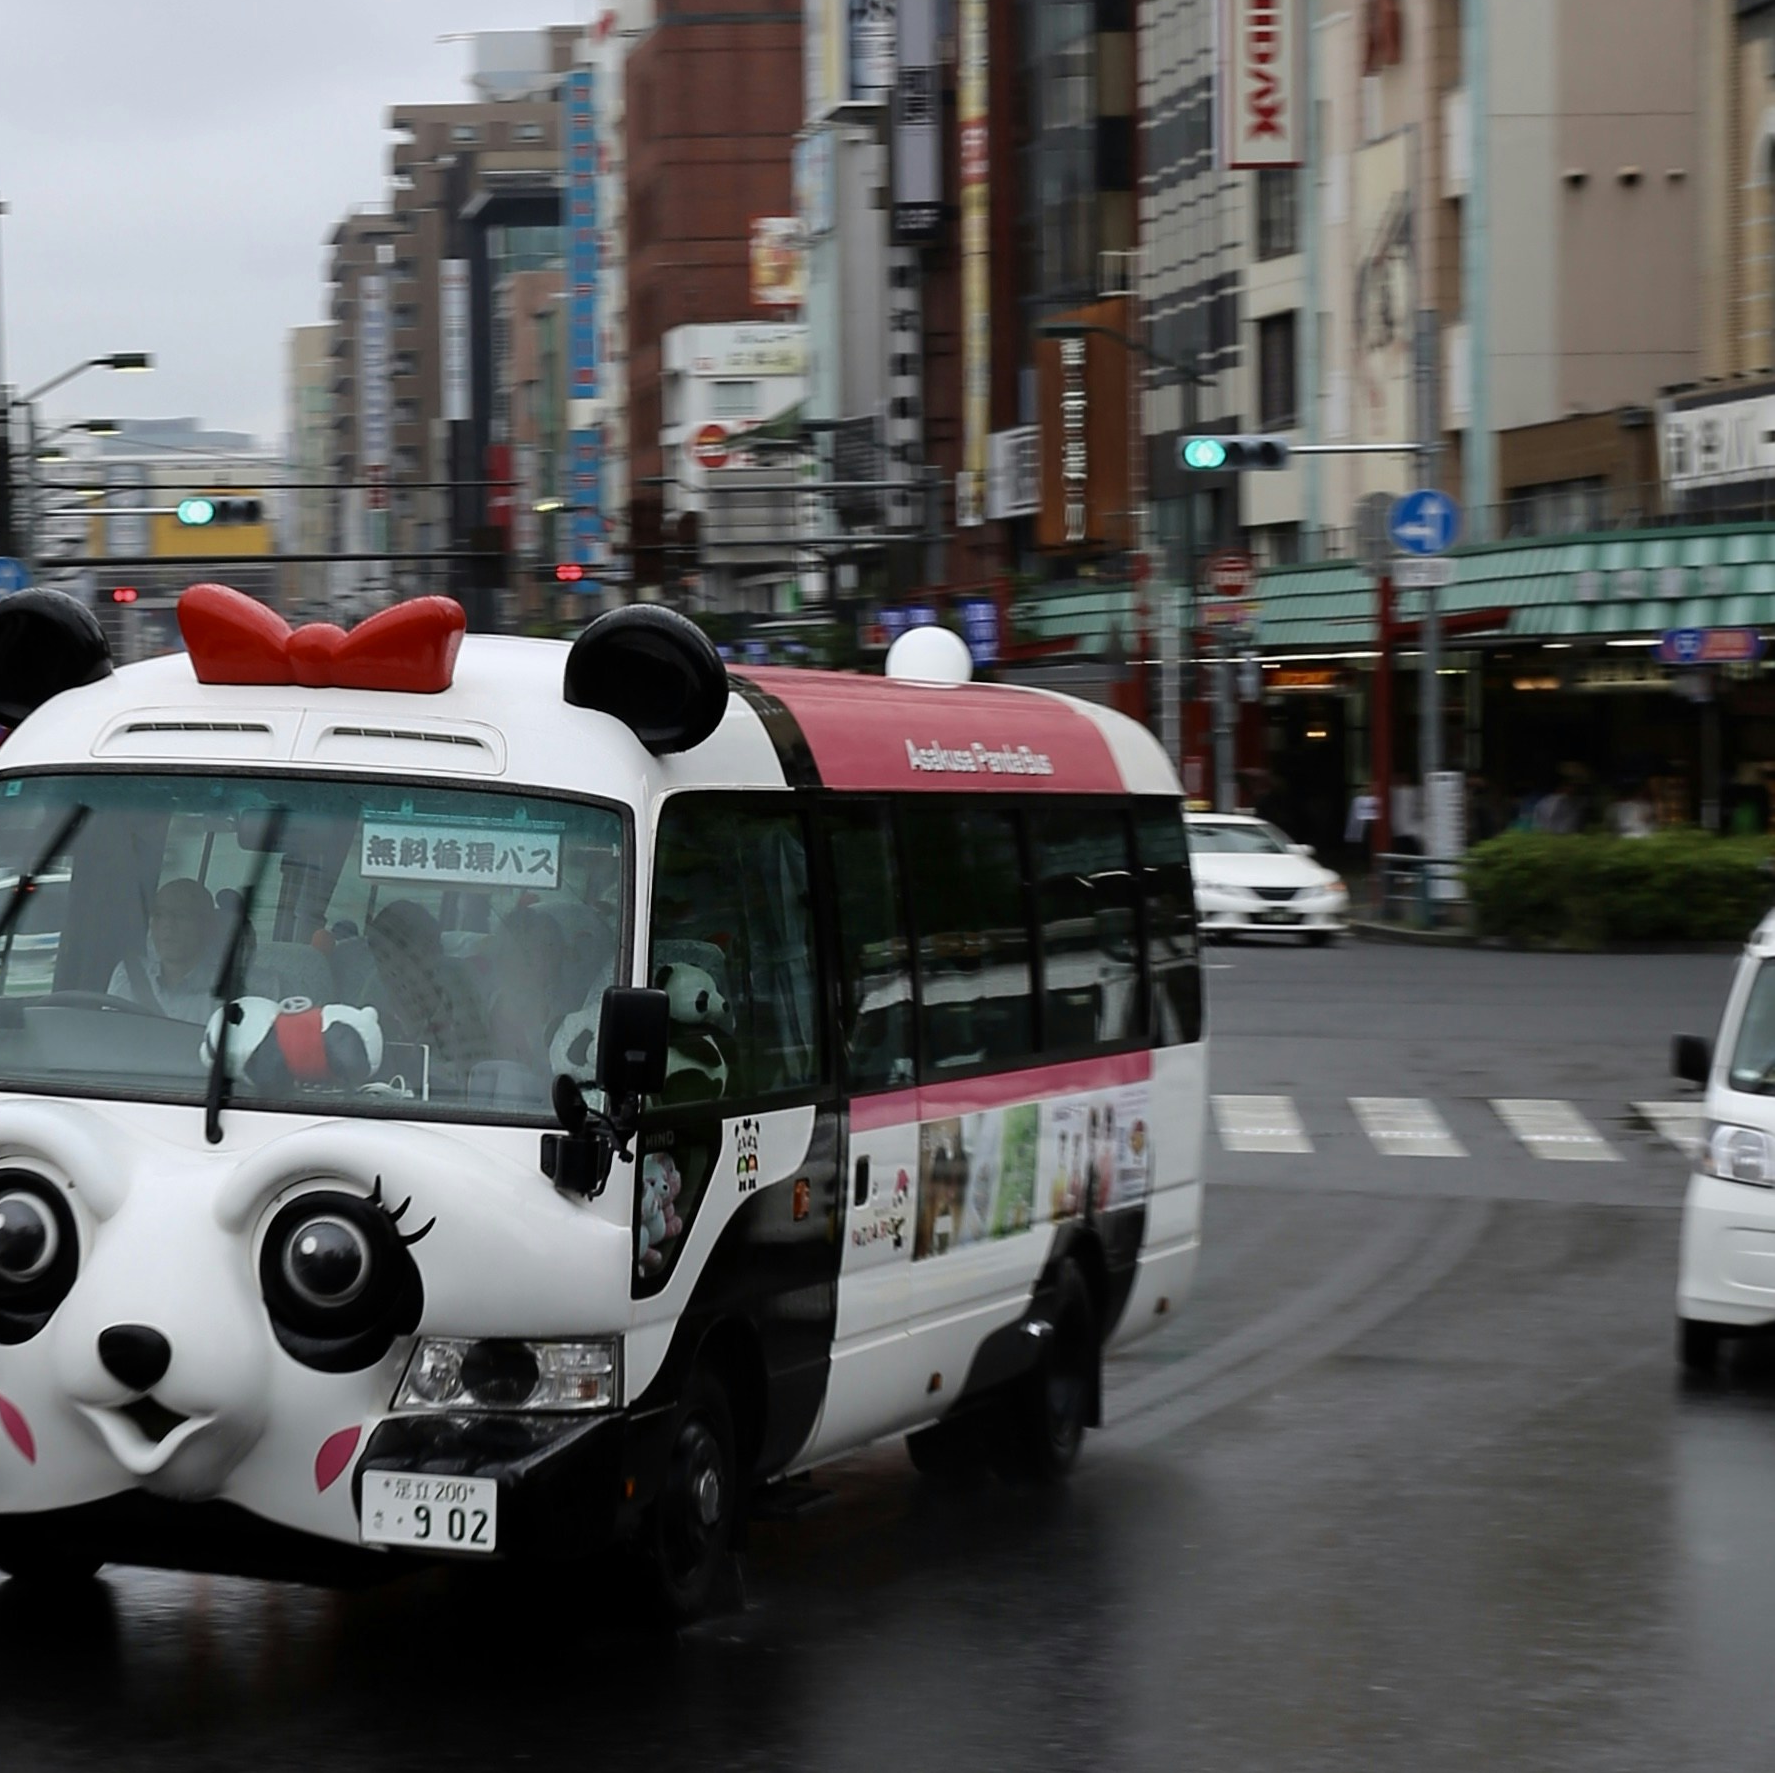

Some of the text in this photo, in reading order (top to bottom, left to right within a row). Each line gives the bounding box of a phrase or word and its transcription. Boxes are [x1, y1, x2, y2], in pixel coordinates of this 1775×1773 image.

[905, 738, 1055, 775] Asakusa Panda Bus
[366, 834, 555, 876] 無料循環バス
[645, 1130, 674, 1147] HINO
